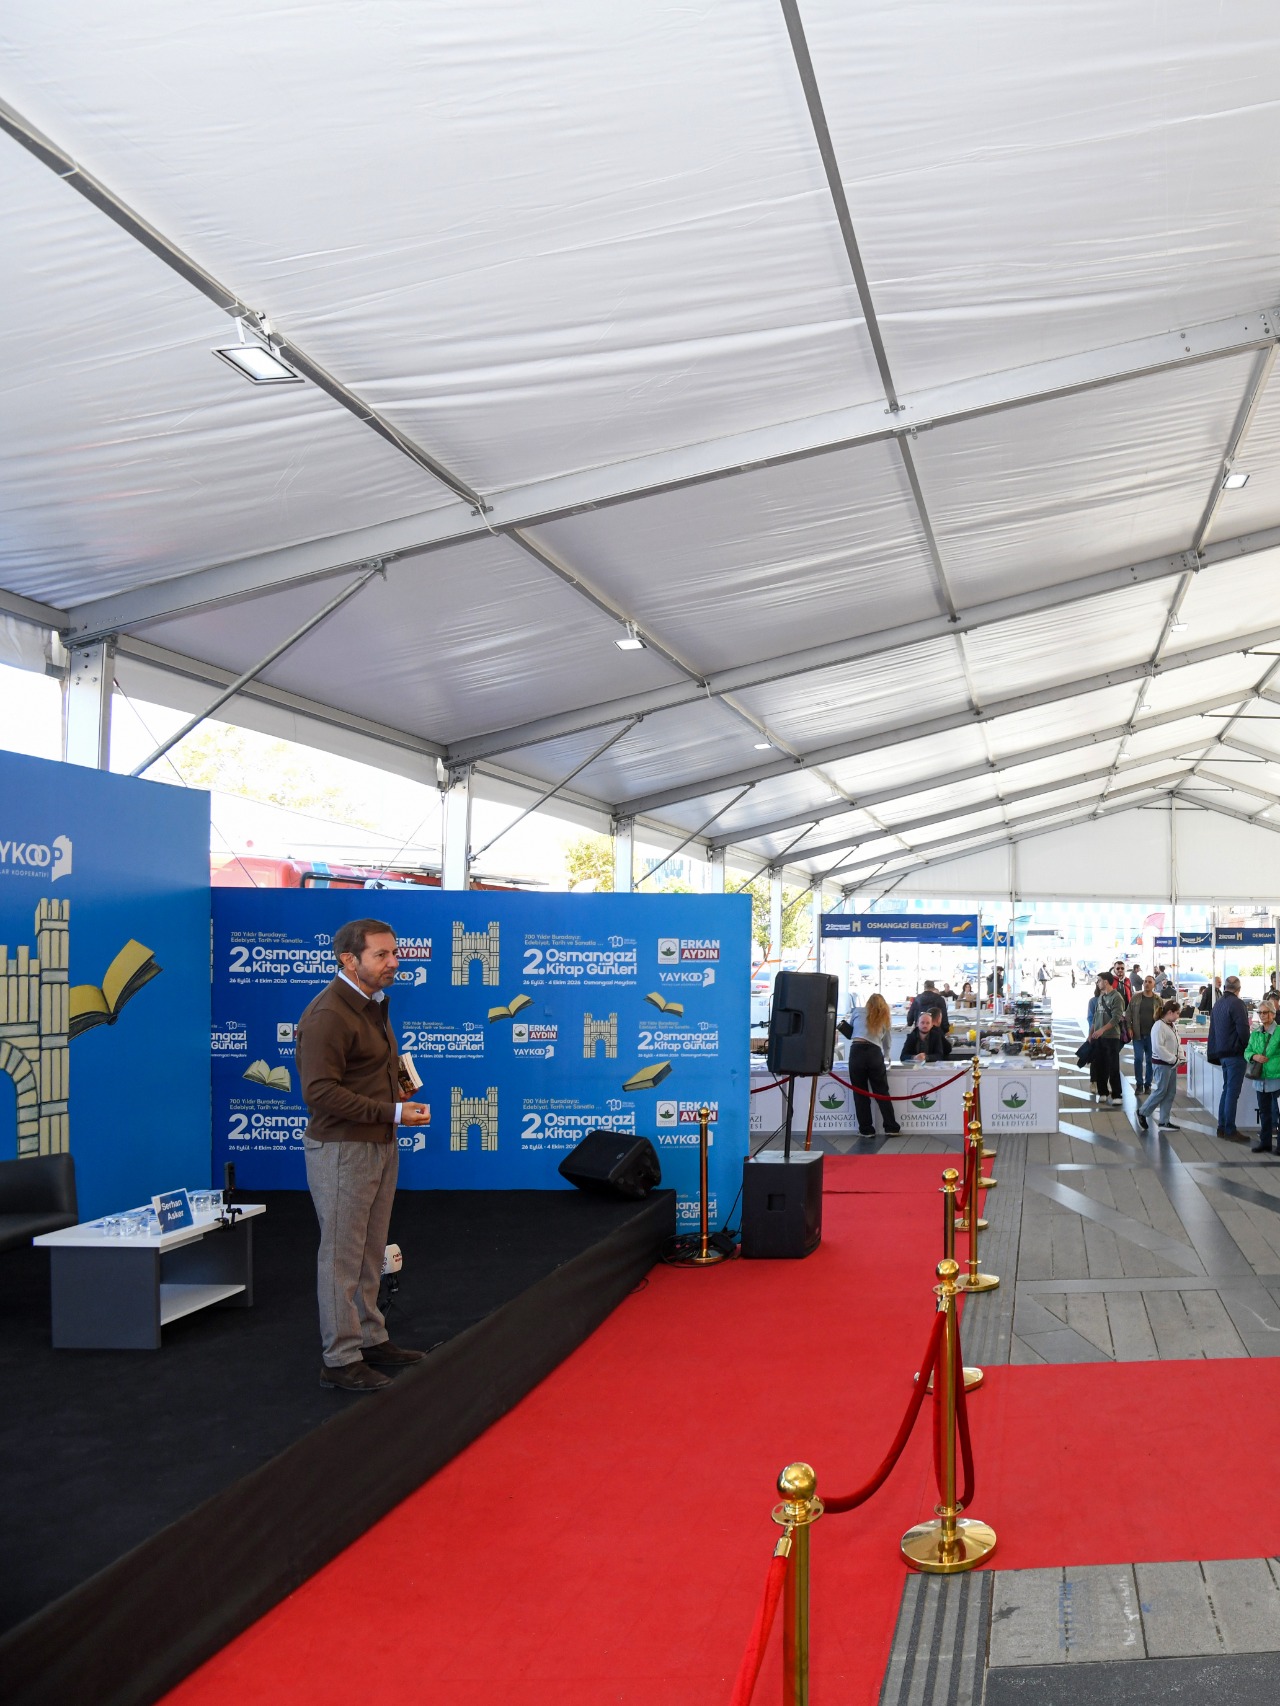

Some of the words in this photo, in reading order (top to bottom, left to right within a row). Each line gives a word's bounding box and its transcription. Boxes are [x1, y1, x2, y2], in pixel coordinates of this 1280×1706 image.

[0, 838, 70, 874] YKOOP
[867, 922, 909, 930] OSMANGAZİ
[911, 922, 949, 930] BELEDİYESİ
[681, 939, 720, 949] ERKAN
[682, 949, 718, 959] AYDIN
[229, 946, 252, 974] 2.
[252, 946, 337, 965] Osmangaz
[523, 948, 546, 975] 2.
[546, 948, 637, 966] Osmangazi
[253, 961, 290, 977] Kitap
[293, 960, 339, 974] Günler
[546, 963, 584, 978] Kitap
[587, 962, 638, 975] Günleri
[529, 1024, 558, 1032] ERKAN
[211, 1030, 247, 1043] angazi
[530, 1031, 557, 1039] AYDIN
[638, 1031, 655, 1051] 2.
[654, 1030, 718, 1044] Osmangazi
[211, 1040, 247, 1050] Günleri
[402, 1031, 419, 1051] 2.
[418, 1031, 483, 1044] Osmangazi
[418, 1041, 446, 1053] Kitap
[448, 1041, 485, 1051] Günleri
[654, 1041, 682, 1053] Kitap
[683, 1041, 719, 1051] Günleri
[680, 1101, 718, 1111] ERKAN
[681, 1111, 716, 1121] AYN
[900, 1112, 948, 1121] OSMANGAZİ
[991, 1112, 1038, 1121] OSMANGAZİ
[228, 1113, 251, 1141] 2.
[251, 1113, 309, 1128] Osman
[521, 1113, 544, 1140] 2.
[544, 1111, 636, 1130] Osmangazi
[813, 1121, 857, 1129] ELEDİYESİ
[252, 1127, 290, 1143] Kitap
[545, 1126, 583, 1142] Kitap
[658, 1134, 703, 1145] YAYKOO
[161, 1200, 183, 1211] Serhan
[167, 1210, 184, 1221] Asker
